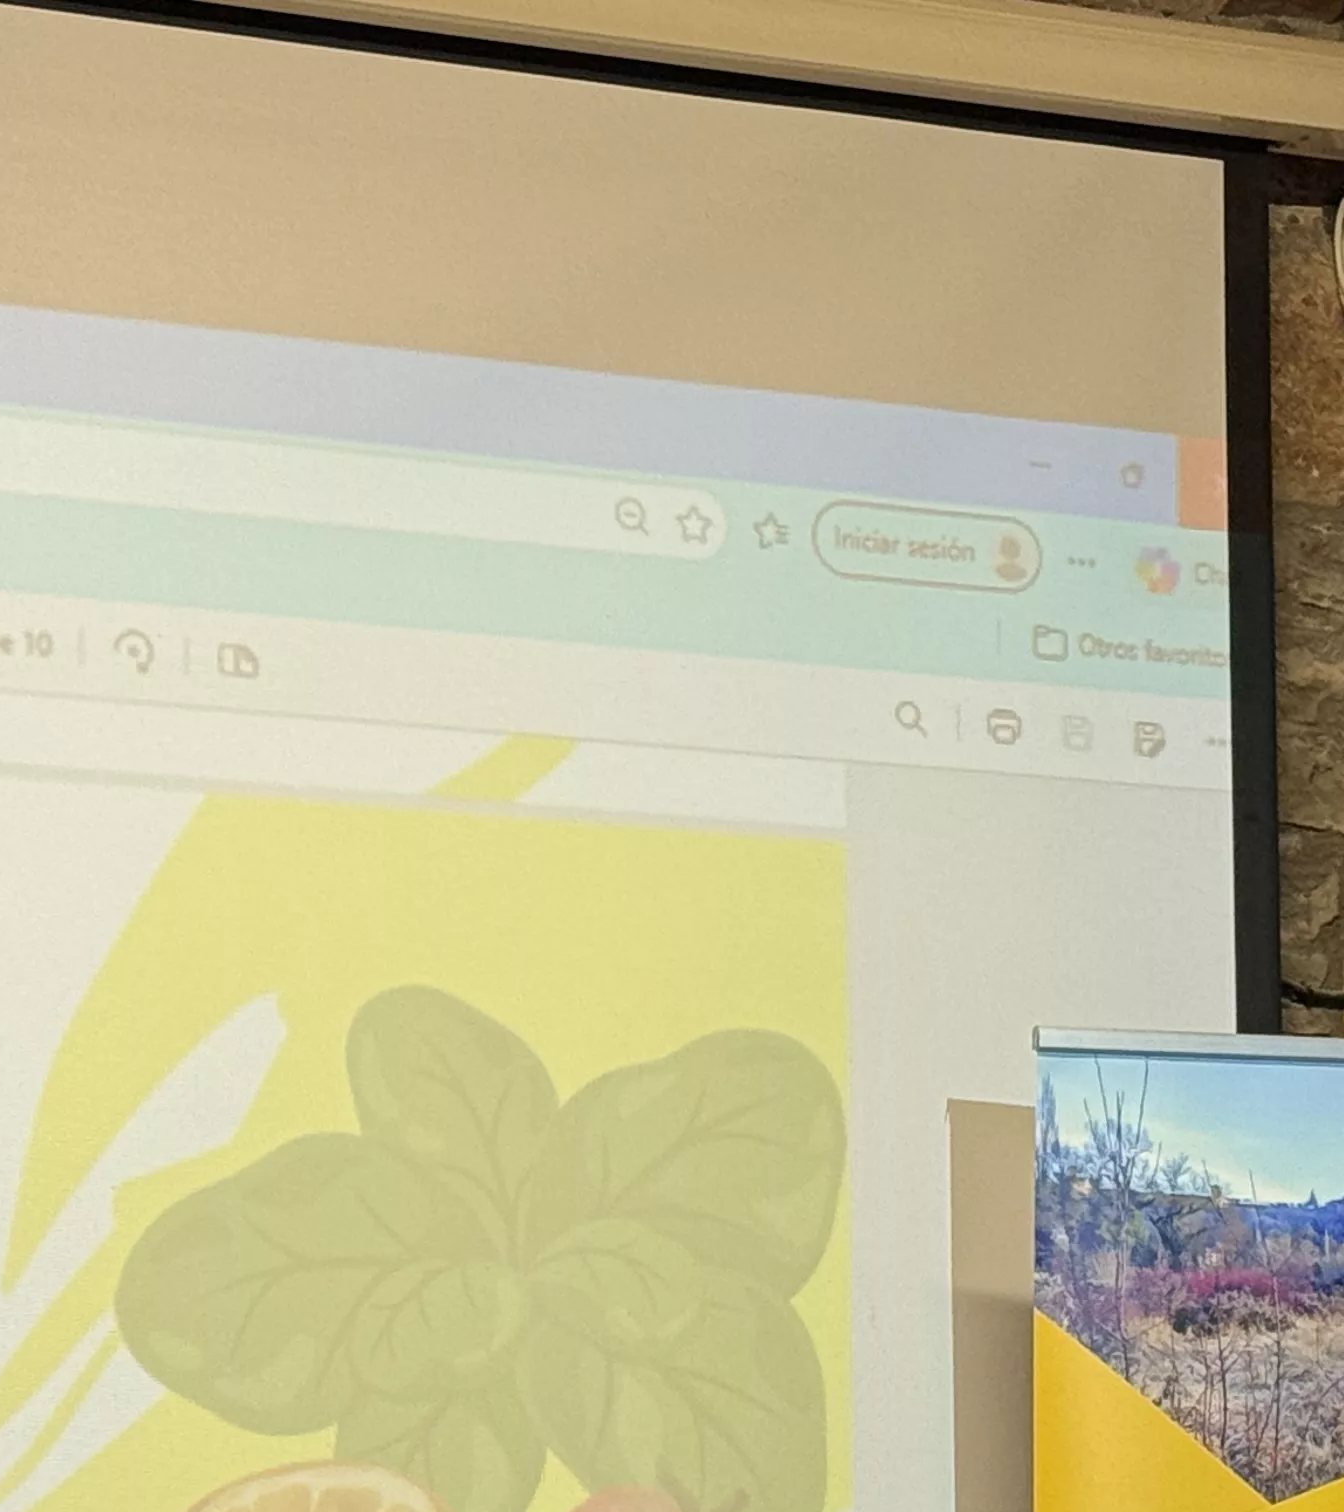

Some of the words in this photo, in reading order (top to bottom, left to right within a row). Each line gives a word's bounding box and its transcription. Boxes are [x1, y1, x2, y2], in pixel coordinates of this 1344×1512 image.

[833, 525, 901, 557] Iniciar
[908, 535, 977, 563] sesión
[22, 627, 56, 658] 10
[1077, 631, 1139, 663] Otros
